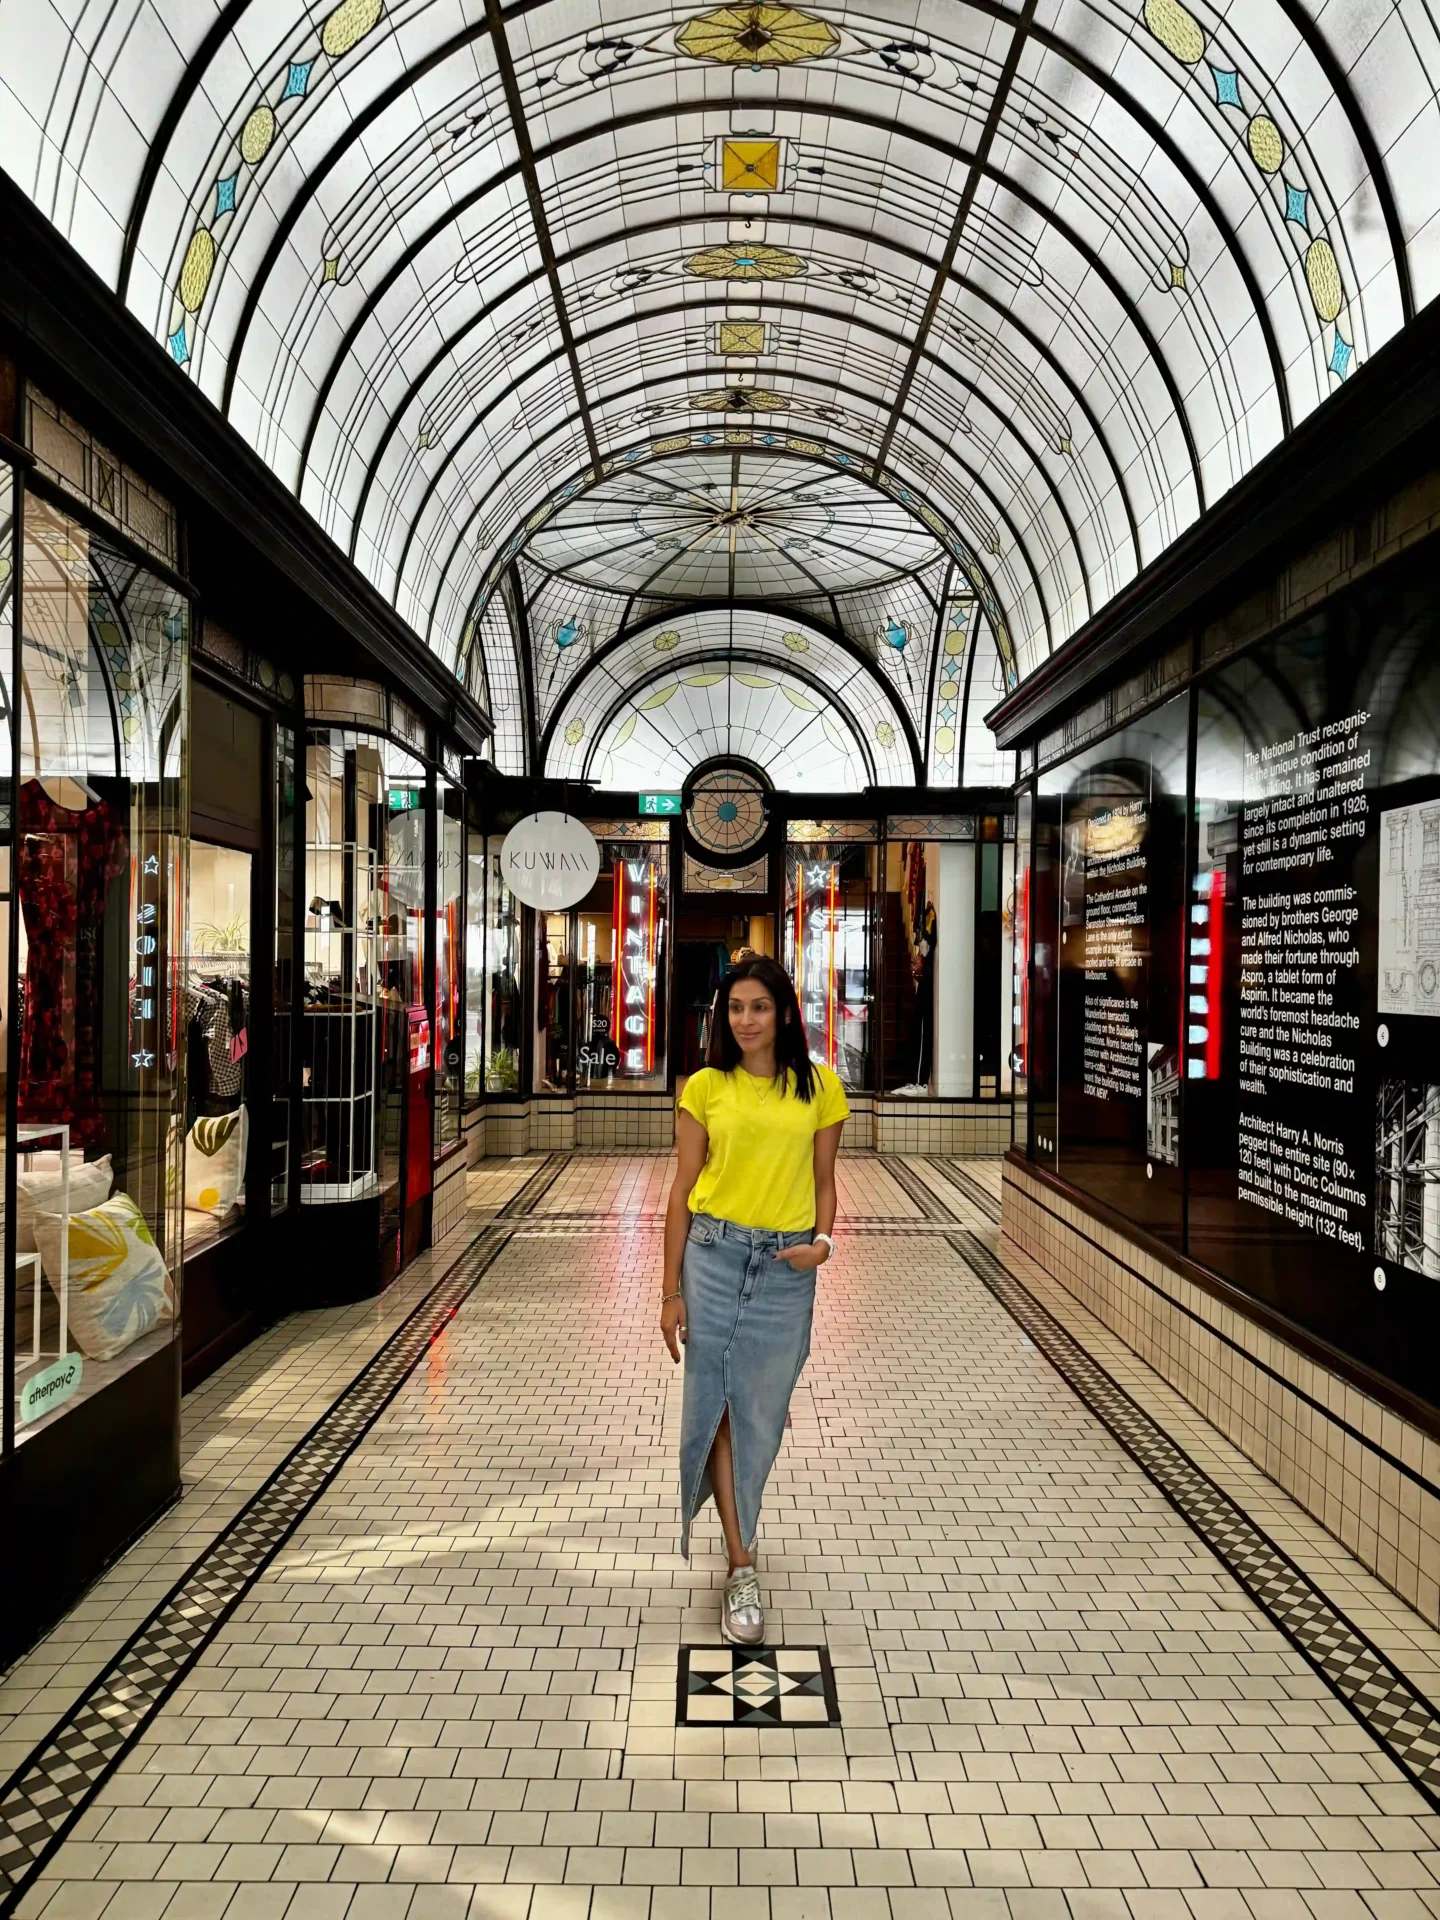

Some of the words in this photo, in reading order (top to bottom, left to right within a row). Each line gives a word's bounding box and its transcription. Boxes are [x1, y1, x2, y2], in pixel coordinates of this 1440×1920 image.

[1246, 752, 1259, 767] The
[1262, 735, 1295, 761] National
[1298, 727, 1320, 747] Trust
[1323, 710, 1371, 738] recognis-
[1270, 758, 1298, 776] unique
[1301, 741, 1345, 765] condition
[1348, 732, 1358, 750] of
[1296, 773, 1302, 788] It
[1303, 768, 1320, 786] has
[1323, 749, 1370, 778] remained
[1130, 800, 1143, 812] Harry
[1244, 802, 1270, 821] largely
[1272, 792, 1295, 813] intact
[1298, 786, 1315, 806] and
[1317, 773, 1364, 801] unaltered
[1244, 825, 1264, 839] since
[1266, 820, 1276, 833] its
[1278, 808, 1327, 830] completion
[1331, 803, 1339, 818] in
[1343, 795, 1368, 814] 1926,
[1244, 843, 1255, 860] yet
[1257, 838, 1271, 854] still
[1273, 837, 1280, 850] is
[1282, 838, 1287, 849] a
[1290, 827, 1328, 849] dynamic
[1330, 820, 1365, 838] setting
[1107, 862, 1126, 874] Nicholas
[1127, 856, 1147, 869] Building.
[1243, 861, 1254, 874] for
[1256, 852, 1315, 872] contemporary
[1317, 846, 1334, 862] life.
[1095, 890, 1114, 902] Cathedral
[1115, 887, 1131, 898] Arcade
[1243, 896, 1256, 910] The
[1259, 893, 1291, 909] building
[1293, 892, 1311, 905] was
[1314, 884, 1357, 903] commis-
[1086, 905, 1100, 919] ground
[1101, 905, 1111, 914] floor,
[1112, 900, 1137, 912] connecting
[1242, 913, 1268, 928] sioned
[1270, 913, 1280, 929] by
[1282, 910, 1319, 925] brothers
[1322, 907, 1358, 924] George
[1086, 918, 1105, 929] Swanston
[1126, 914, 1144, 924] Flinders
[1086, 933, 1096, 942] Lane
[1118, 928, 1132, 939] extant
[1242, 932, 1256, 946] and
[1258, 931, 1282, 945] Alfred
[1284, 929, 1325, 945] Nicholas,
[1328, 927, 1349, 942] who
[624, 863, 645, 1069] VINTAGE
[1242, 951, 1263, 964] made
[1264, 950, 1284, 964] their
[1285, 950, 1318, 964] fortune
[1320, 948, 1359, 967] through
[1085, 970, 1107, 980] Melbourne.
[1241, 969, 1266, 985] Aspro,
[1268, 972, 1273, 983] a
[1275, 969, 1300, 983] tablet
[1302, 969, 1323, 984] form
[1326, 969, 1336, 984] of
[1099, 997, 1124, 1008] significance
[1241, 987, 1270, 1003] Aspirin.
[1272, 988, 1278, 1002] It
[1280, 988, 1315, 1004] became
[1317, 990, 1333, 1005] the
[1241, 1006, 1268, 1020] world's
[1270, 1007, 1309, 1024] foremost
[1311, 1010, 1360, 1028] headache
[1085, 1021, 1101, 1034] cladding
[1116, 1025, 1138, 1039] Building's
[1241, 1026, 1257, 1037] cure
[1259, 1026, 1274, 1039] and
[1276, 1026, 1290, 1041] the
[1292, 1028, 1332, 1047] Nicholas
[1121, 1039, 1134, 1051] faced
[1241, 1040, 1271, 1061] Building
[1274, 1049, 1291, 1061] was
[1293, 1051, 1298, 1062] a
[1301, 1051, 1355, 1071] celebration
[580, 1046, 616, 1066] Sale
[1110, 1051, 1138, 1066] Architectural
[1102, 1076, 1119, 1092] building
[1125, 1083, 1142, 1097] always
[1240, 1059, 1247, 1072] of
[1249, 1060, 1267, 1075] their
[1269, 1066, 1331, 1088] sophistication
[1334, 1077, 1353, 1093] and
[1240, 1079, 1267, 1094] wealth.
[1239, 1112, 1274, 1134] Architect
[1277, 1122, 1300, 1145] Harry
[1302, 1130, 1311, 1145] A.
[1314, 1133, 1344, 1155] Norris
[1239, 1133, 1268, 1151] pegged
[1270, 1140, 1283, 1156] the
[1285, 1148, 1311, 1165] entire
[1313, 1154, 1330, 1172] site
[1333, 1159, 1348, 1178] (90
[1349, 1169, 1355, 1179] x
[1240, 1148, 1252, 1164] 120
[1254, 1153, 1271, 1174] feet)
[1274, 1162, 1291, 1179] with
[1294, 1166, 1318, 1188] Doric
[1321, 1176, 1366, 1206] Columns
[1239, 1169, 1252, 1183] and
[1255, 1172, 1272, 1191] built
[1274, 1180, 1282, 1195] to
[1284, 1184, 1298, 1201] the
[1301, 1193, 1348, 1220] maximum
[1239, 1187, 1284, 1214] permissible
[1286, 1203, 1314, 1228] height
[1316, 1216, 1336, 1238] (132
[1338, 1225, 1365, 1252] feet).
[29, 1373, 66, 1405] afterpay
